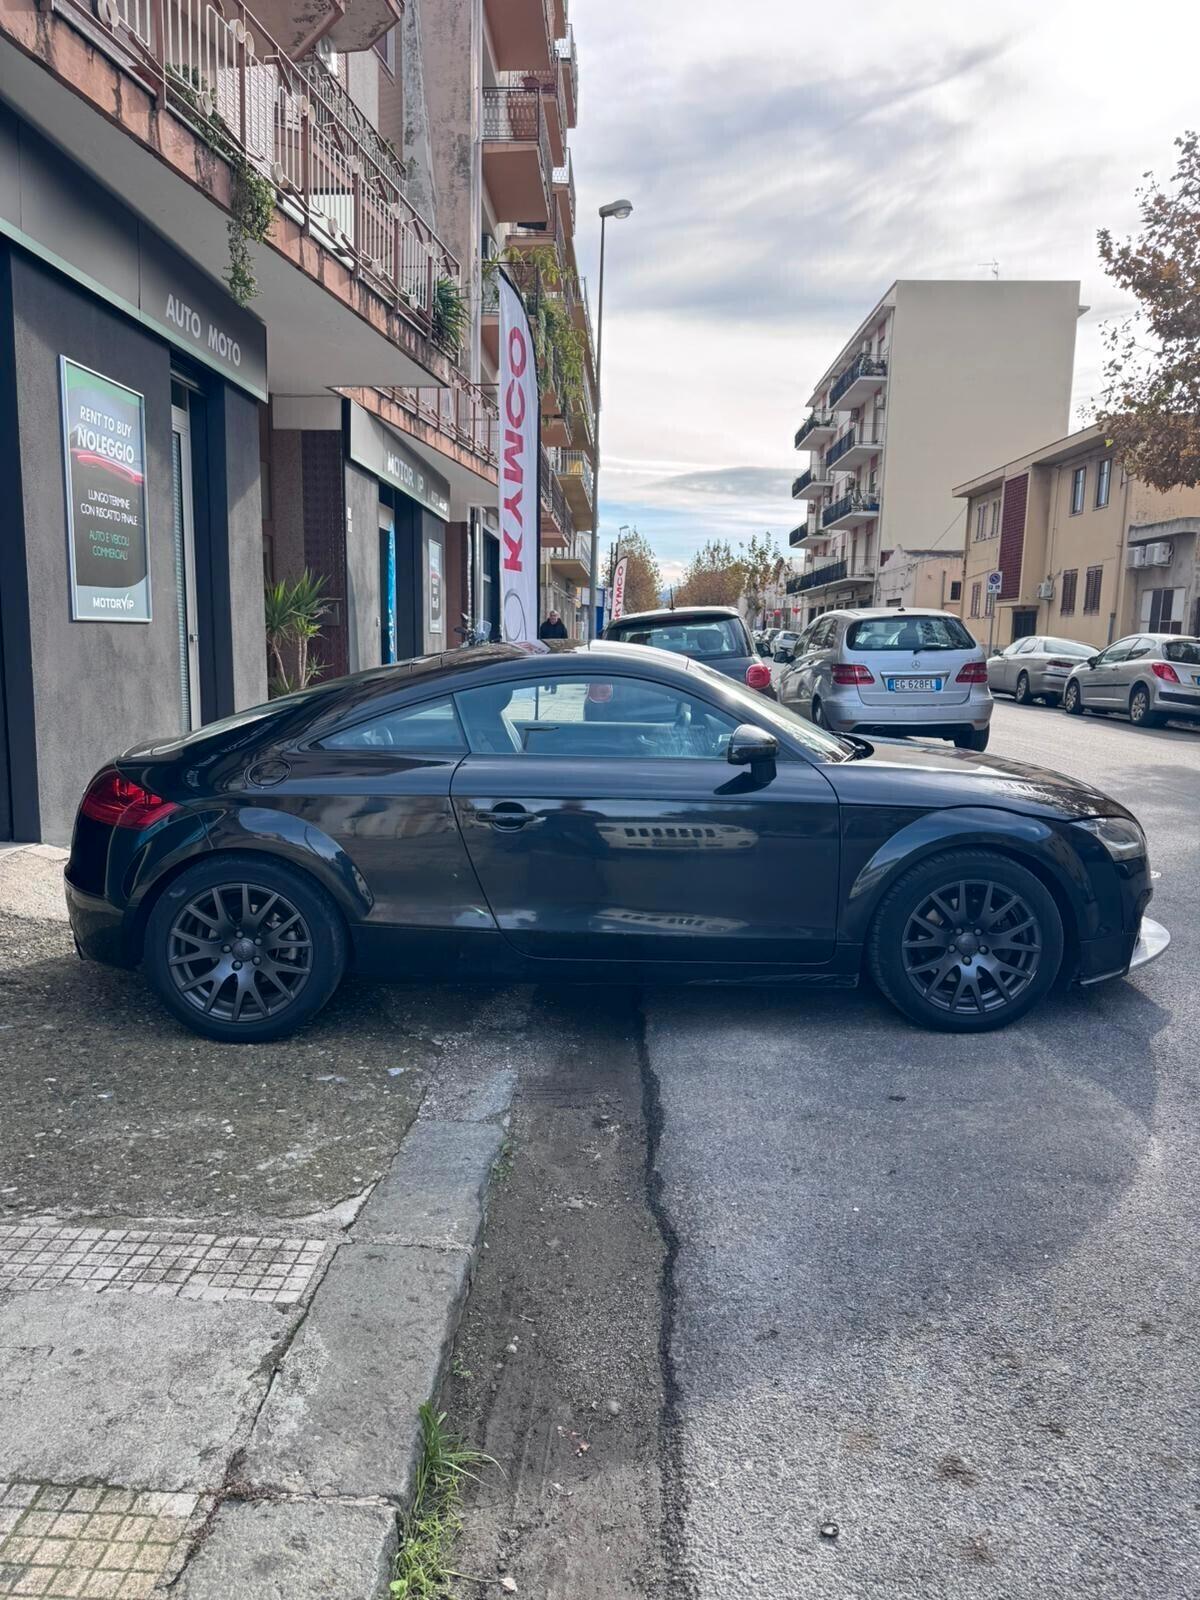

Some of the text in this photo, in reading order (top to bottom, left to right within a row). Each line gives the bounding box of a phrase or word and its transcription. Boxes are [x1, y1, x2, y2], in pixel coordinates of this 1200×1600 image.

[166, 293, 241, 367] AUTO MOTO
[80, 405, 132, 438] RENT TO BUY
[77, 426, 135, 464] NOLEGGIO
[87, 489, 130, 510] LUNGO TERMINE
[80, 502, 138, 526] CON RISCATTO FINALE
[89, 530, 105, 542] AUTO
[105, 532, 110, 543] E
[92, 593, 135, 610] MOTORVIP
[614, 565, 624, 618] KYMCO
